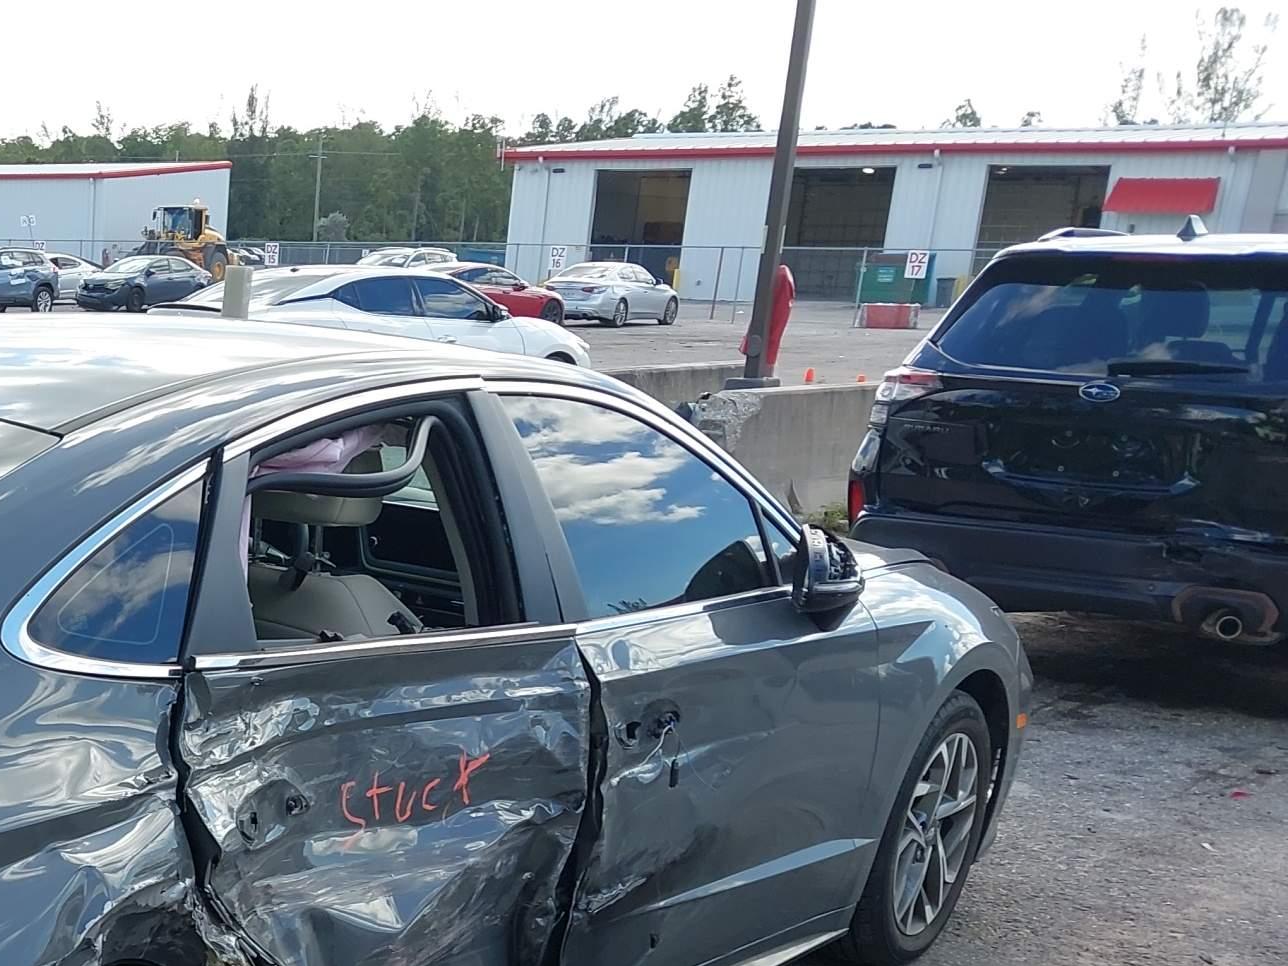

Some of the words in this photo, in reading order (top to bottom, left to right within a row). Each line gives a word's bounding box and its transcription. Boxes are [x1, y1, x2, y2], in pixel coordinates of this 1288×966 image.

[267, 244, 278, 254] DZ
[551, 247, 566, 258] DZ
[268, 255, 276, 264] 15
[552, 258, 561, 268] 16
[909, 252, 928, 264] DZ
[911, 265, 922, 276] 17
